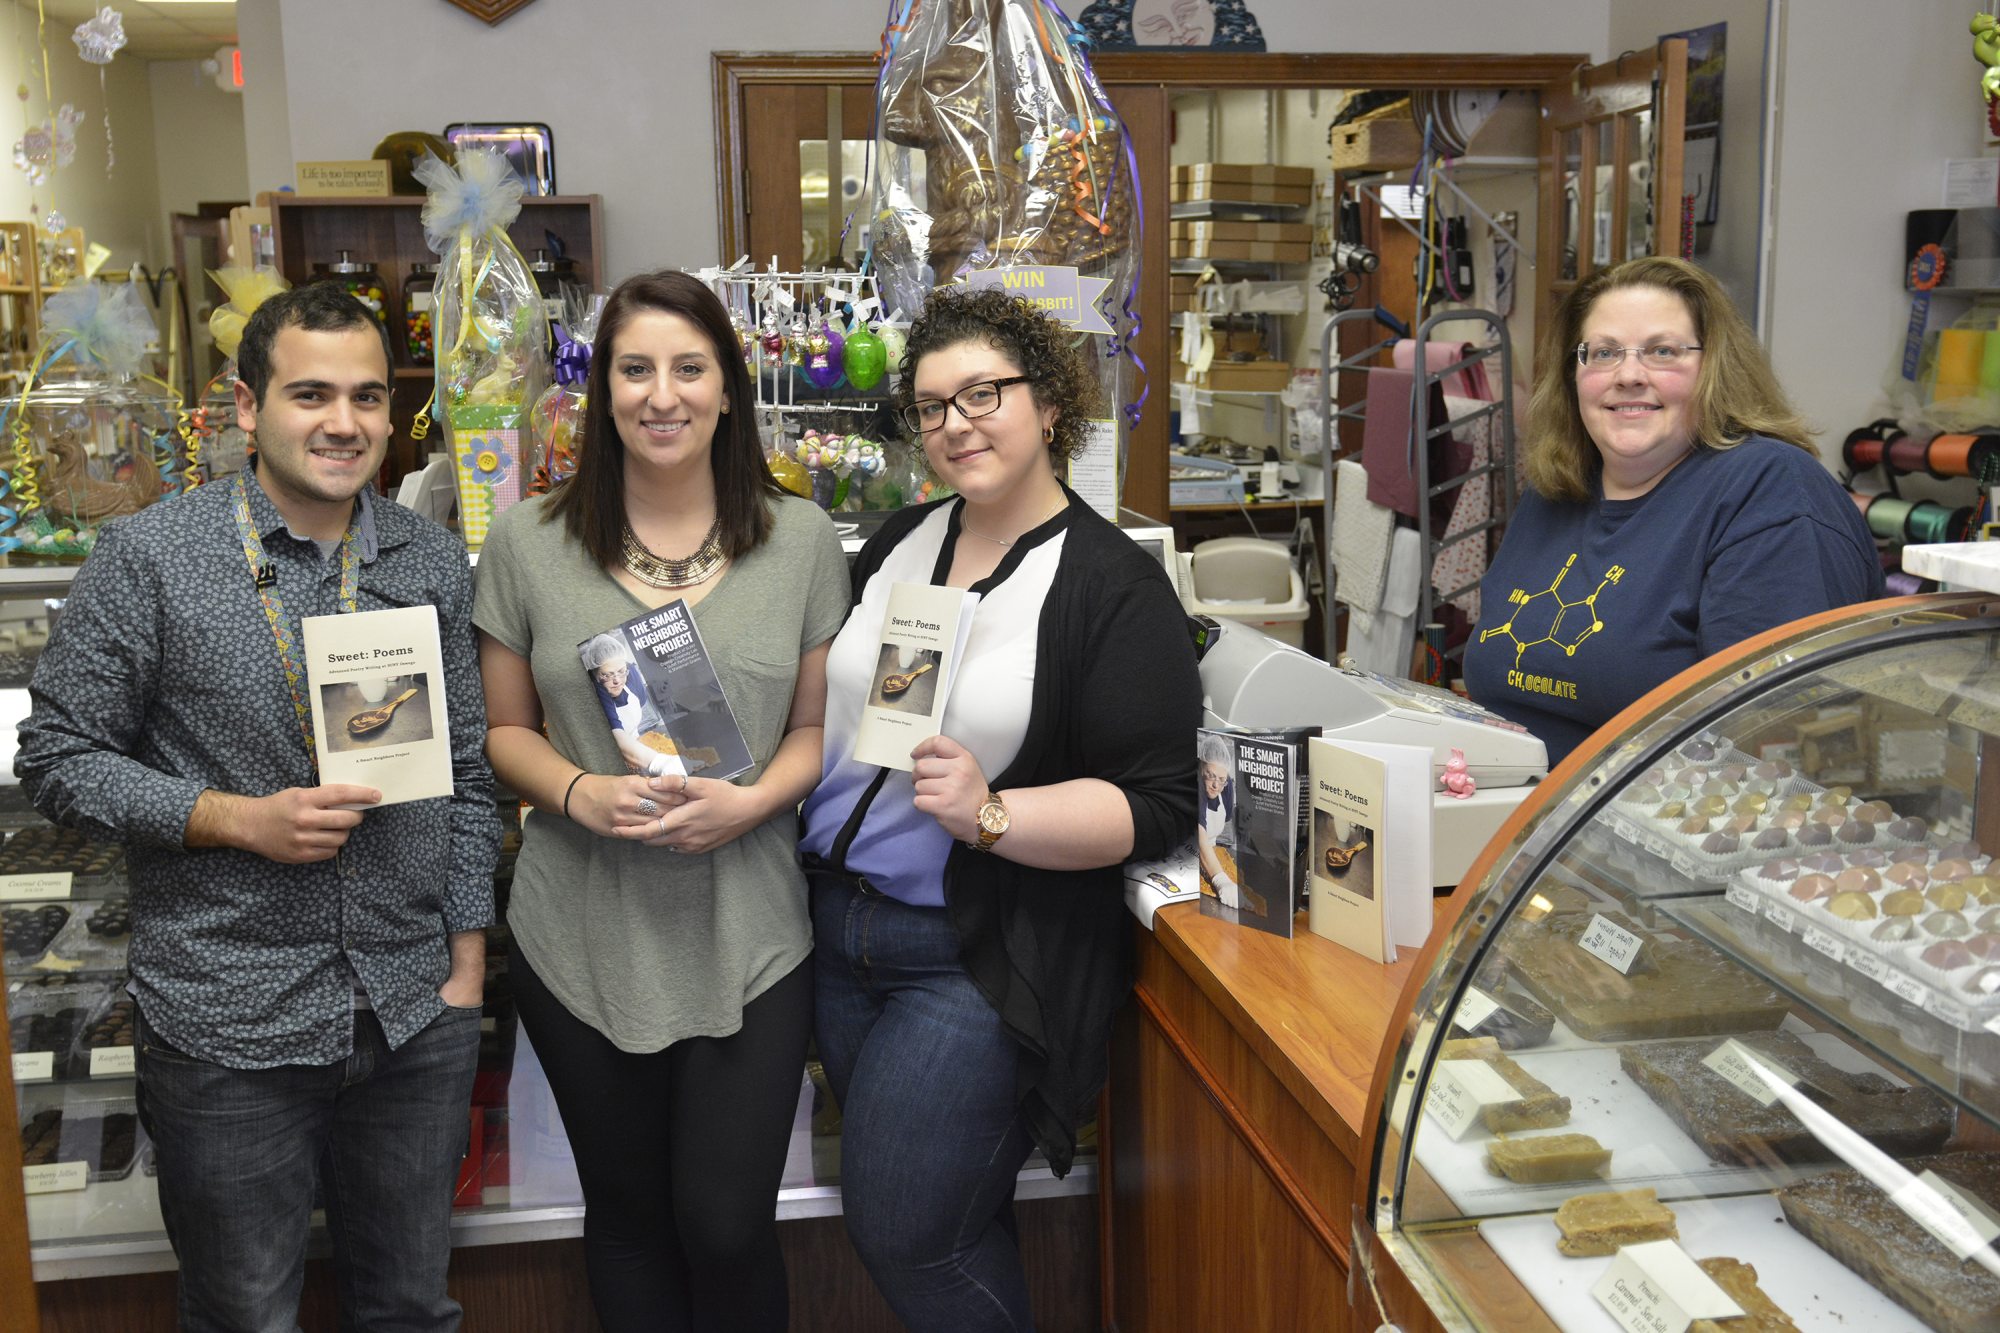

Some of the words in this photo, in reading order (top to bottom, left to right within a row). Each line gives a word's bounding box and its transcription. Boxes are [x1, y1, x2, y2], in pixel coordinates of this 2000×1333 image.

[303, 168, 318, 179] Life
[343, 168, 384, 181] important
[1001, 271, 1045, 289] WIN
[629, 621, 651, 638] THE
[648, 606, 683, 630] SMART
[892, 616, 914, 627] Sweet:
[915, 619, 941, 631] Poems
[632, 619, 689, 651] NEIGHBORS
[652, 631, 694, 658] PROJECT
[328, 652, 369, 663] Sweet:
[373, 647, 414, 659] Poems
[1240, 745, 1255, 760] THE
[1256, 748, 1284, 766] SMART
[1238, 759, 1285, 780] NEIGHBORS
[1250, 775, 1284, 794] PROJECT
[1320, 780, 1343, 797] Sweet:
[1344, 788, 1368, 806] Poems
[1614, 1278, 1642, 1307] Caramel
[1640, 1306, 1654, 1322] Sea
